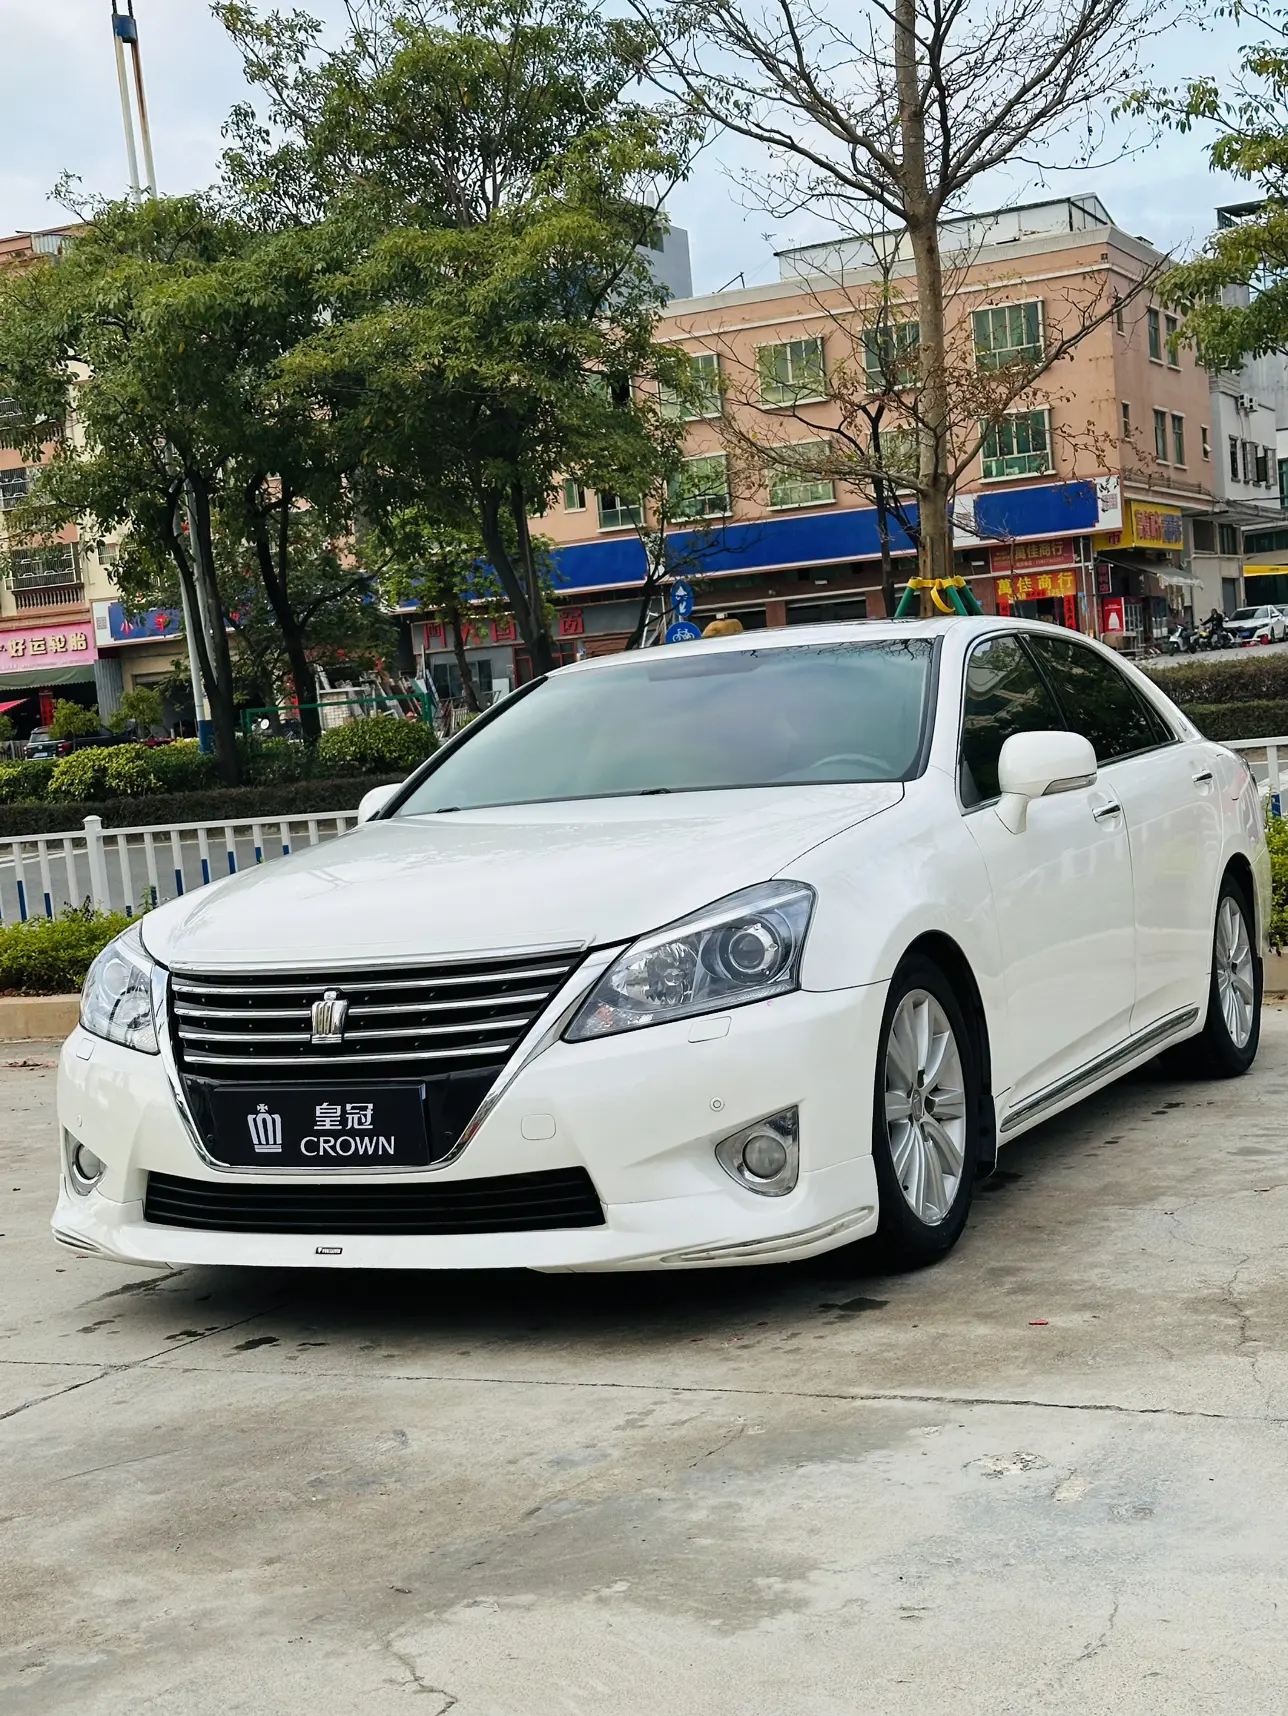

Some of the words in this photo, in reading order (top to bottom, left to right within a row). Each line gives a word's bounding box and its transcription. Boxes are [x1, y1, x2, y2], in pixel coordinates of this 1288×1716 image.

[1015, 542, 1064, 560] 萬佳商行
[997, 571, 1073, 596] 萬佳商行
[313, 1102, 375, 1130] 皇冠
[300, 1135, 395, 1156] CROWN
